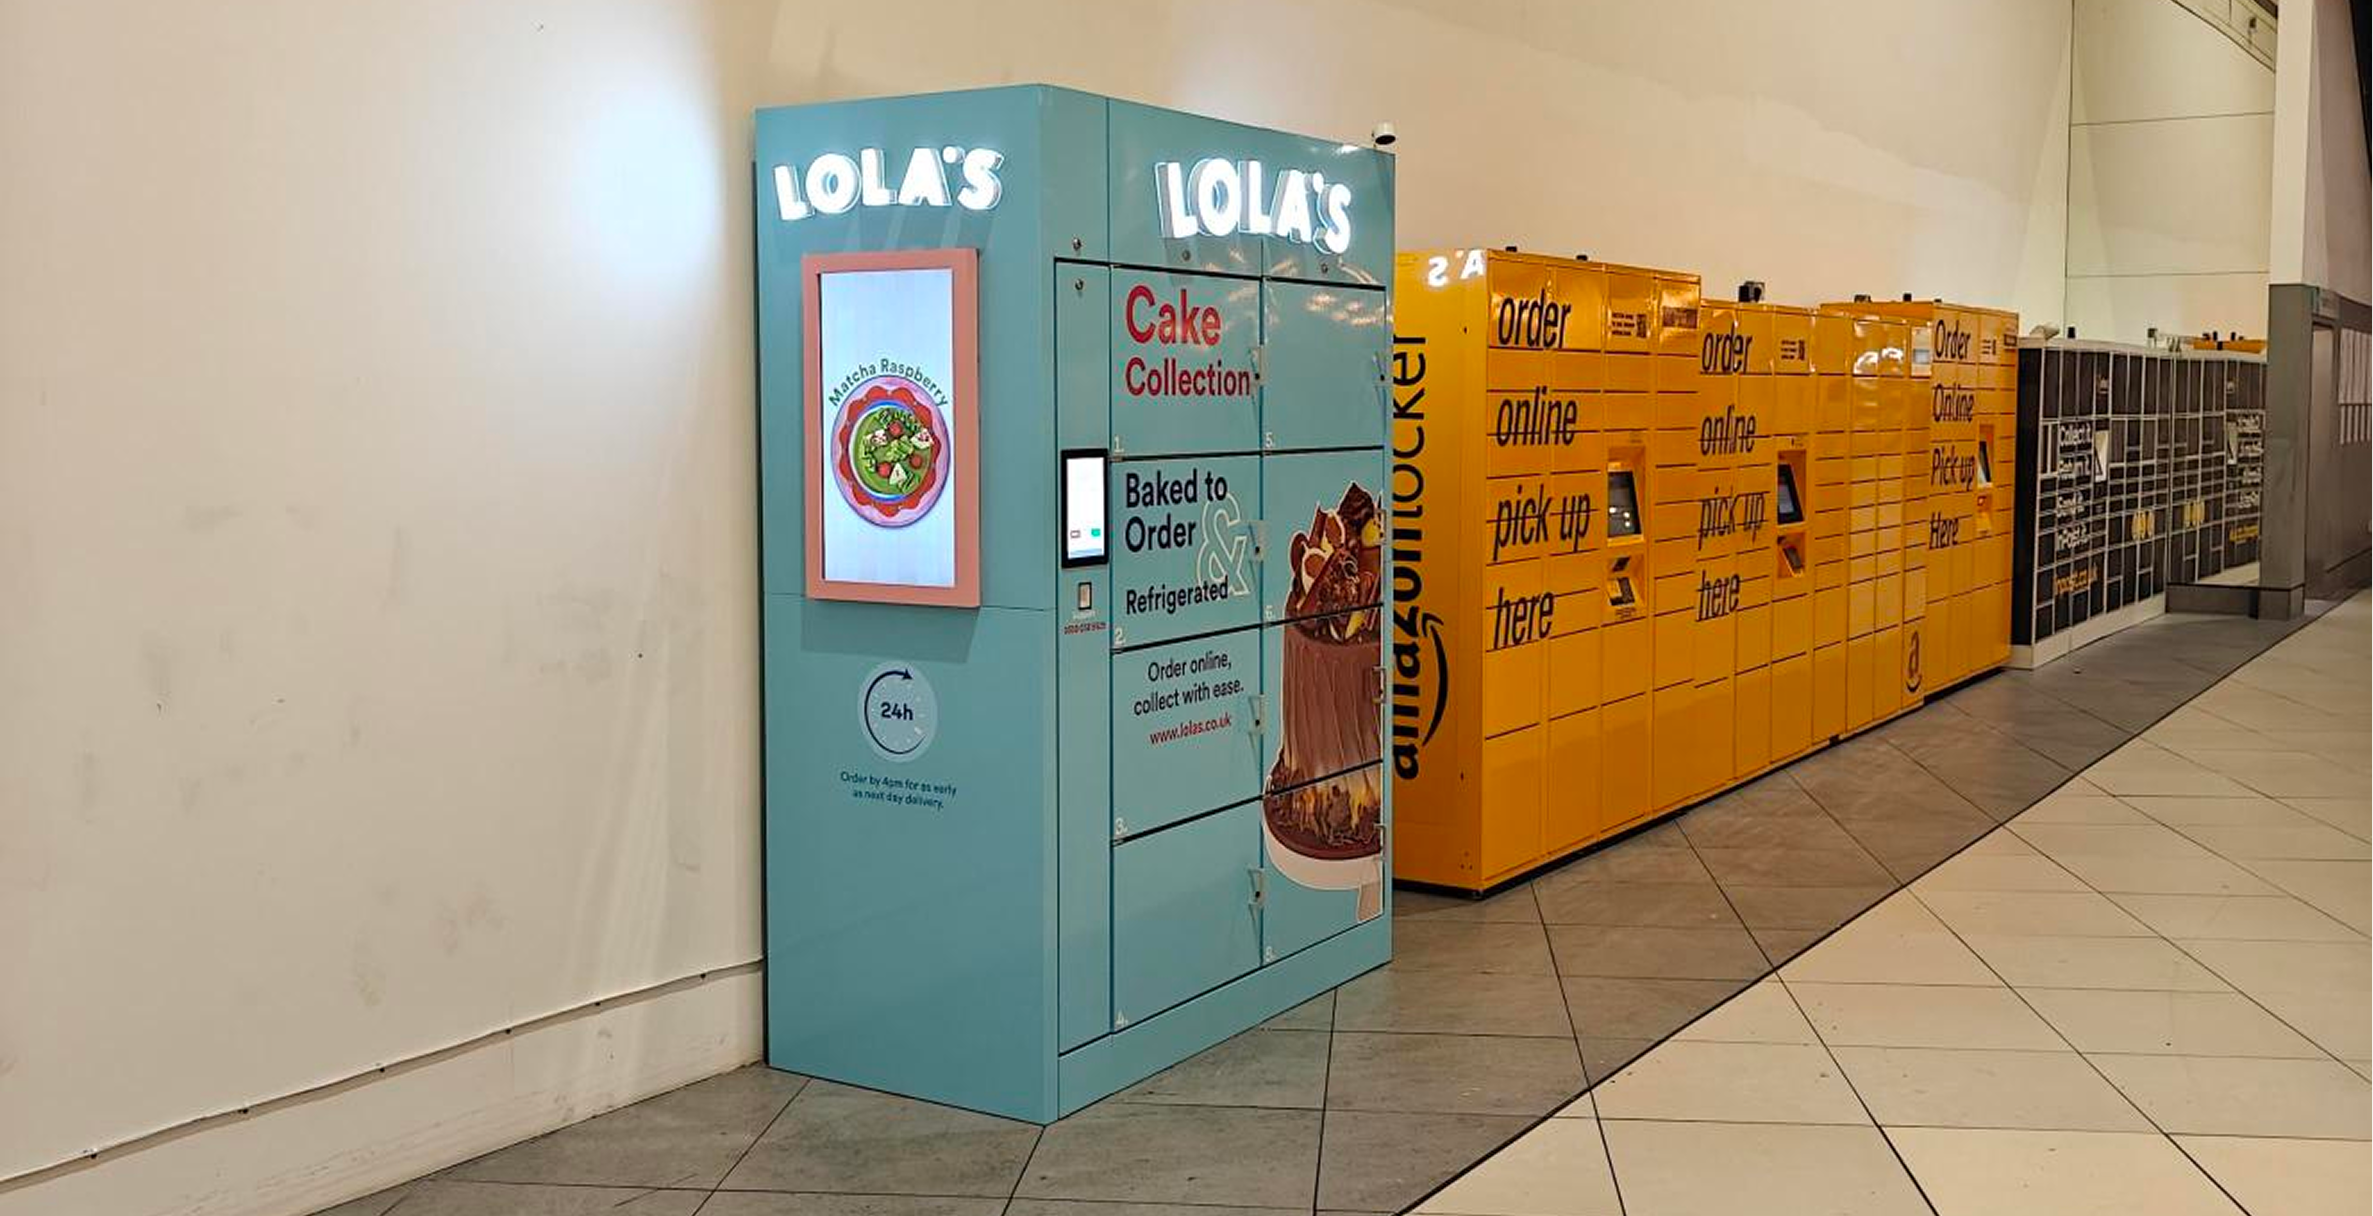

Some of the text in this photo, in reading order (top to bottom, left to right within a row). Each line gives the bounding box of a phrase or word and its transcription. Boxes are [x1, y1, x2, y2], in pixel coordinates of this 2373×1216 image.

[774, 145, 1004, 221] LOLA'S
[1155, 157, 1352, 254] LOLA'S
[1126, 285, 1221, 345] Cake
[1498, 288, 1572, 350] order
[1702, 322, 1753, 374] order
[1935, 319, 1970, 360] Order
[828, 358, 949, 408] Matcha Raspberry
[1126, 357, 1250, 396] Collection
[1497, 385, 1578, 446] online
[1932, 382, 1975, 423] Online
[1700, 404, 1756, 455] online
[1126, 468, 1228, 508] Baked to
[1930, 447, 1976, 491] Pick up
[1125, 513, 1196, 553] Order
[1494, 484, 1590, 561] pick up
[1698, 486, 1766, 551] pick up
[1929, 511, 1959, 550] Here
[1126, 576, 1228, 614] Refrigerated
[1699, 570, 1740, 621] here
[1494, 587, 1555, 650] here
[1148, 650, 1232, 682] Order online,
[881, 702, 913, 720] 24h
[1134, 679, 1244, 716] collect with ease.
[1150, 712, 1231, 744] www.lolas.co.uk
[841, 771, 867, 784] Order
[869, 774, 881, 789] by
[921, 783, 931, 792] as
[933, 784, 957, 799] early
[864, 790, 884, 800] next
[886, 793, 902, 805] day
